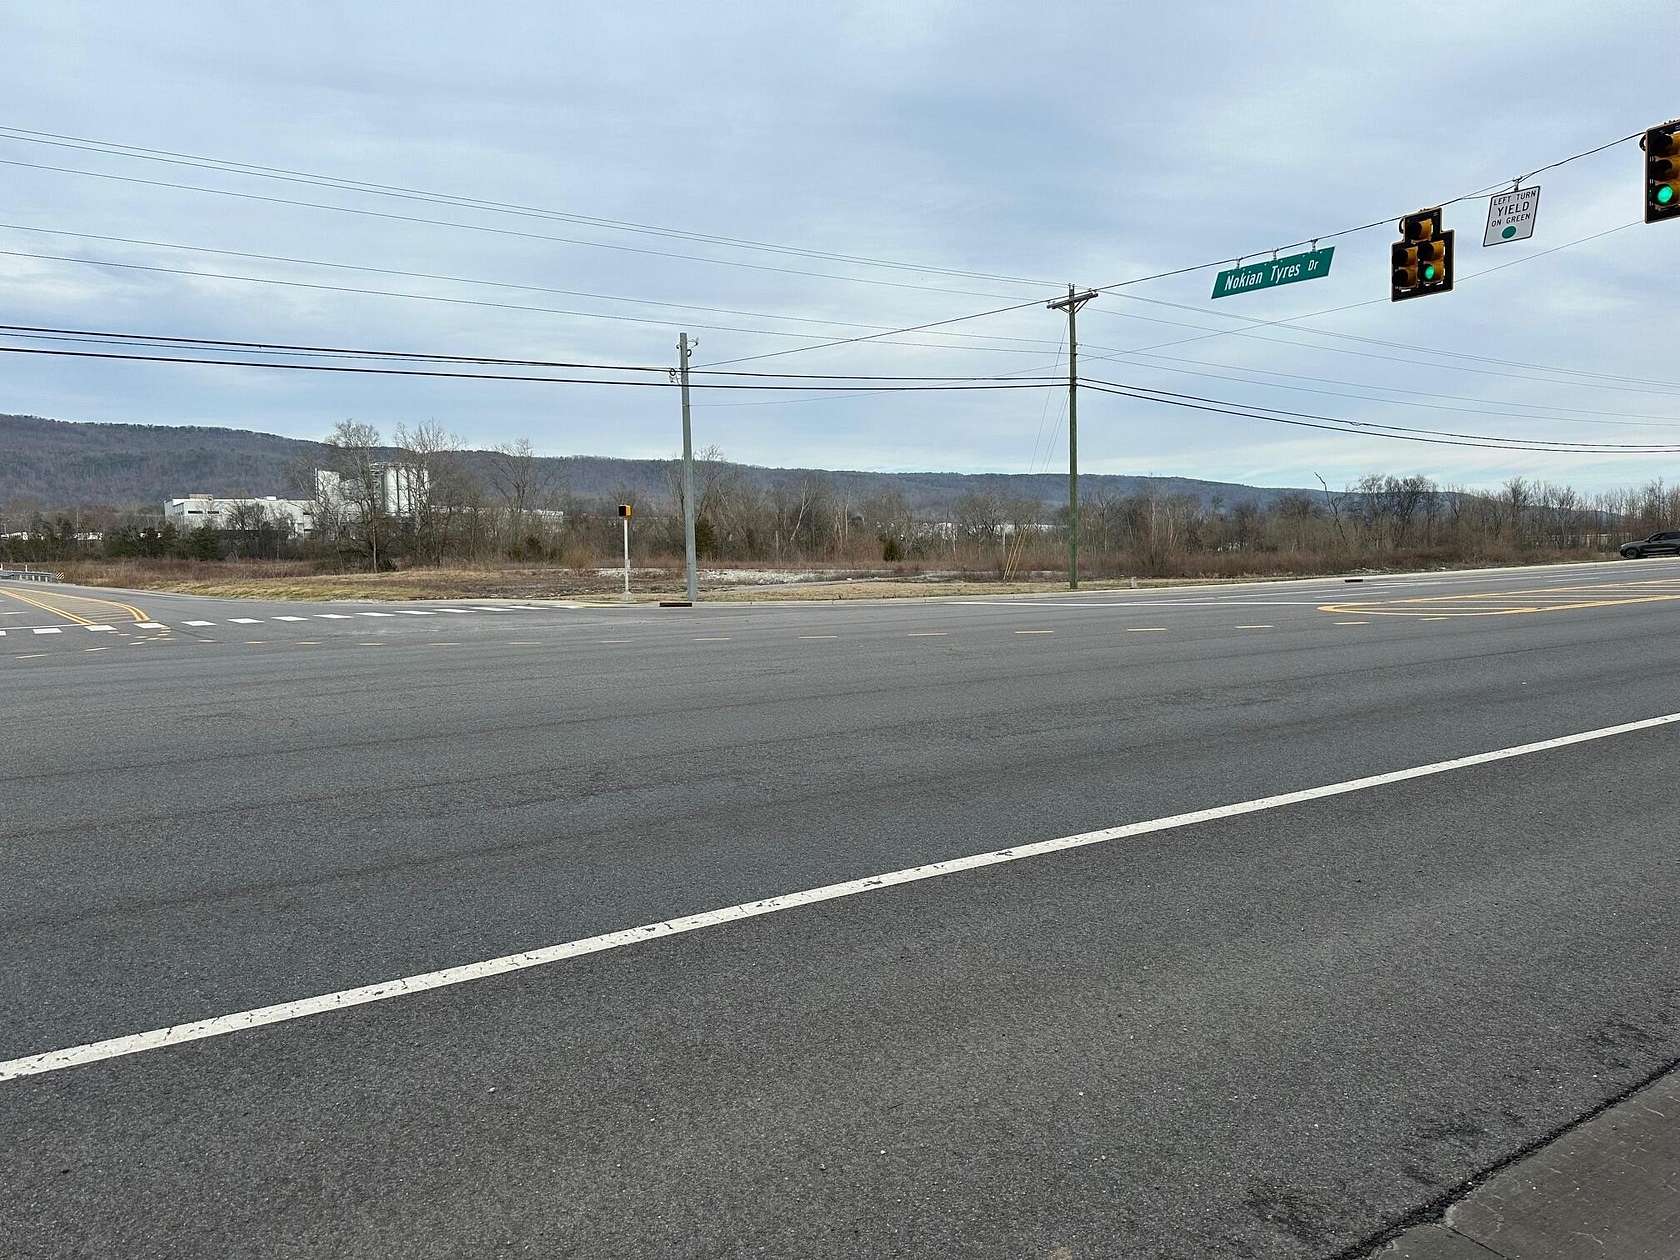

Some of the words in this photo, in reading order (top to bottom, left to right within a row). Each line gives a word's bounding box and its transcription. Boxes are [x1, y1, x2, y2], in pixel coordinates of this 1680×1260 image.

[1493, 195, 1511, 206] LEFT
[1516, 190, 1536, 200] TURN
[1497, 201, 1530, 216] YIELD
[1491, 218, 1502, 227] ON
[1506, 212, 1531, 224] GREEN
[1224, 271, 1263, 291] Nokian
[1270, 263, 1301, 284] Tyres
[1307, 259, 1319, 271] Dr
